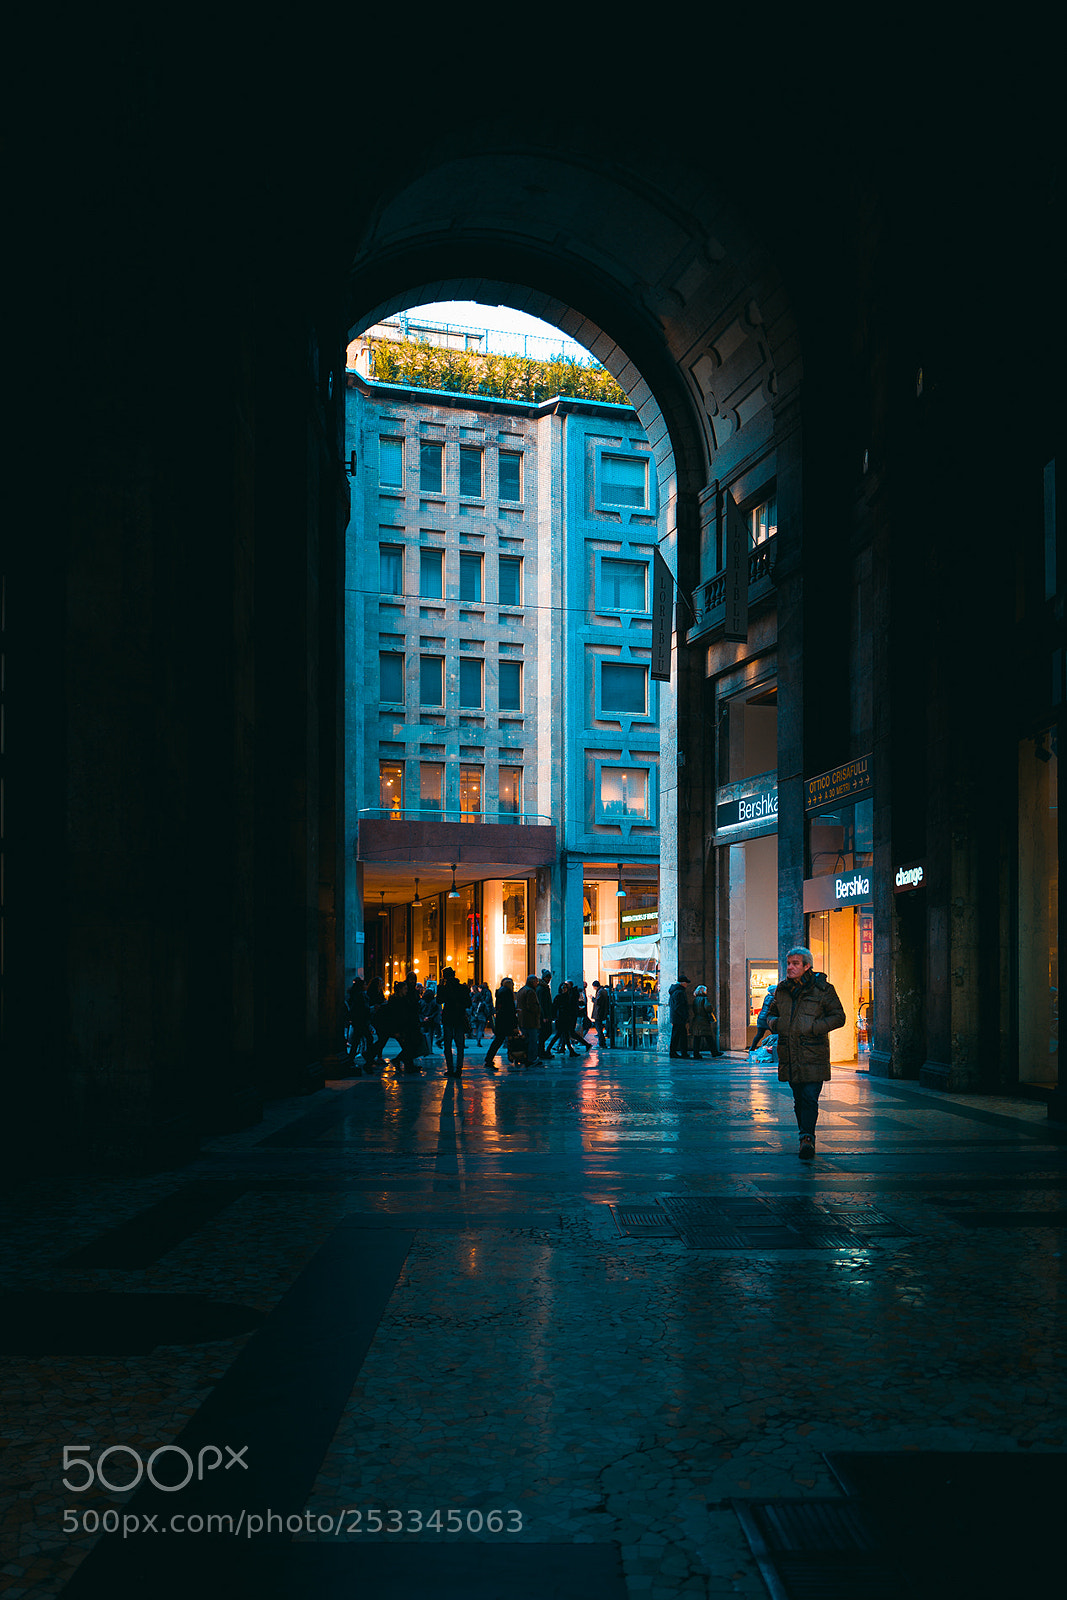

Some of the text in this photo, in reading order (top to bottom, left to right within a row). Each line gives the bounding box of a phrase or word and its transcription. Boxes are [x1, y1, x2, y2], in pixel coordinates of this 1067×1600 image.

[809, 759, 868, 794] OTTICO CRISAFULLI
[836, 875, 870, 899] Bershka
[895, 866, 923, 887] change
